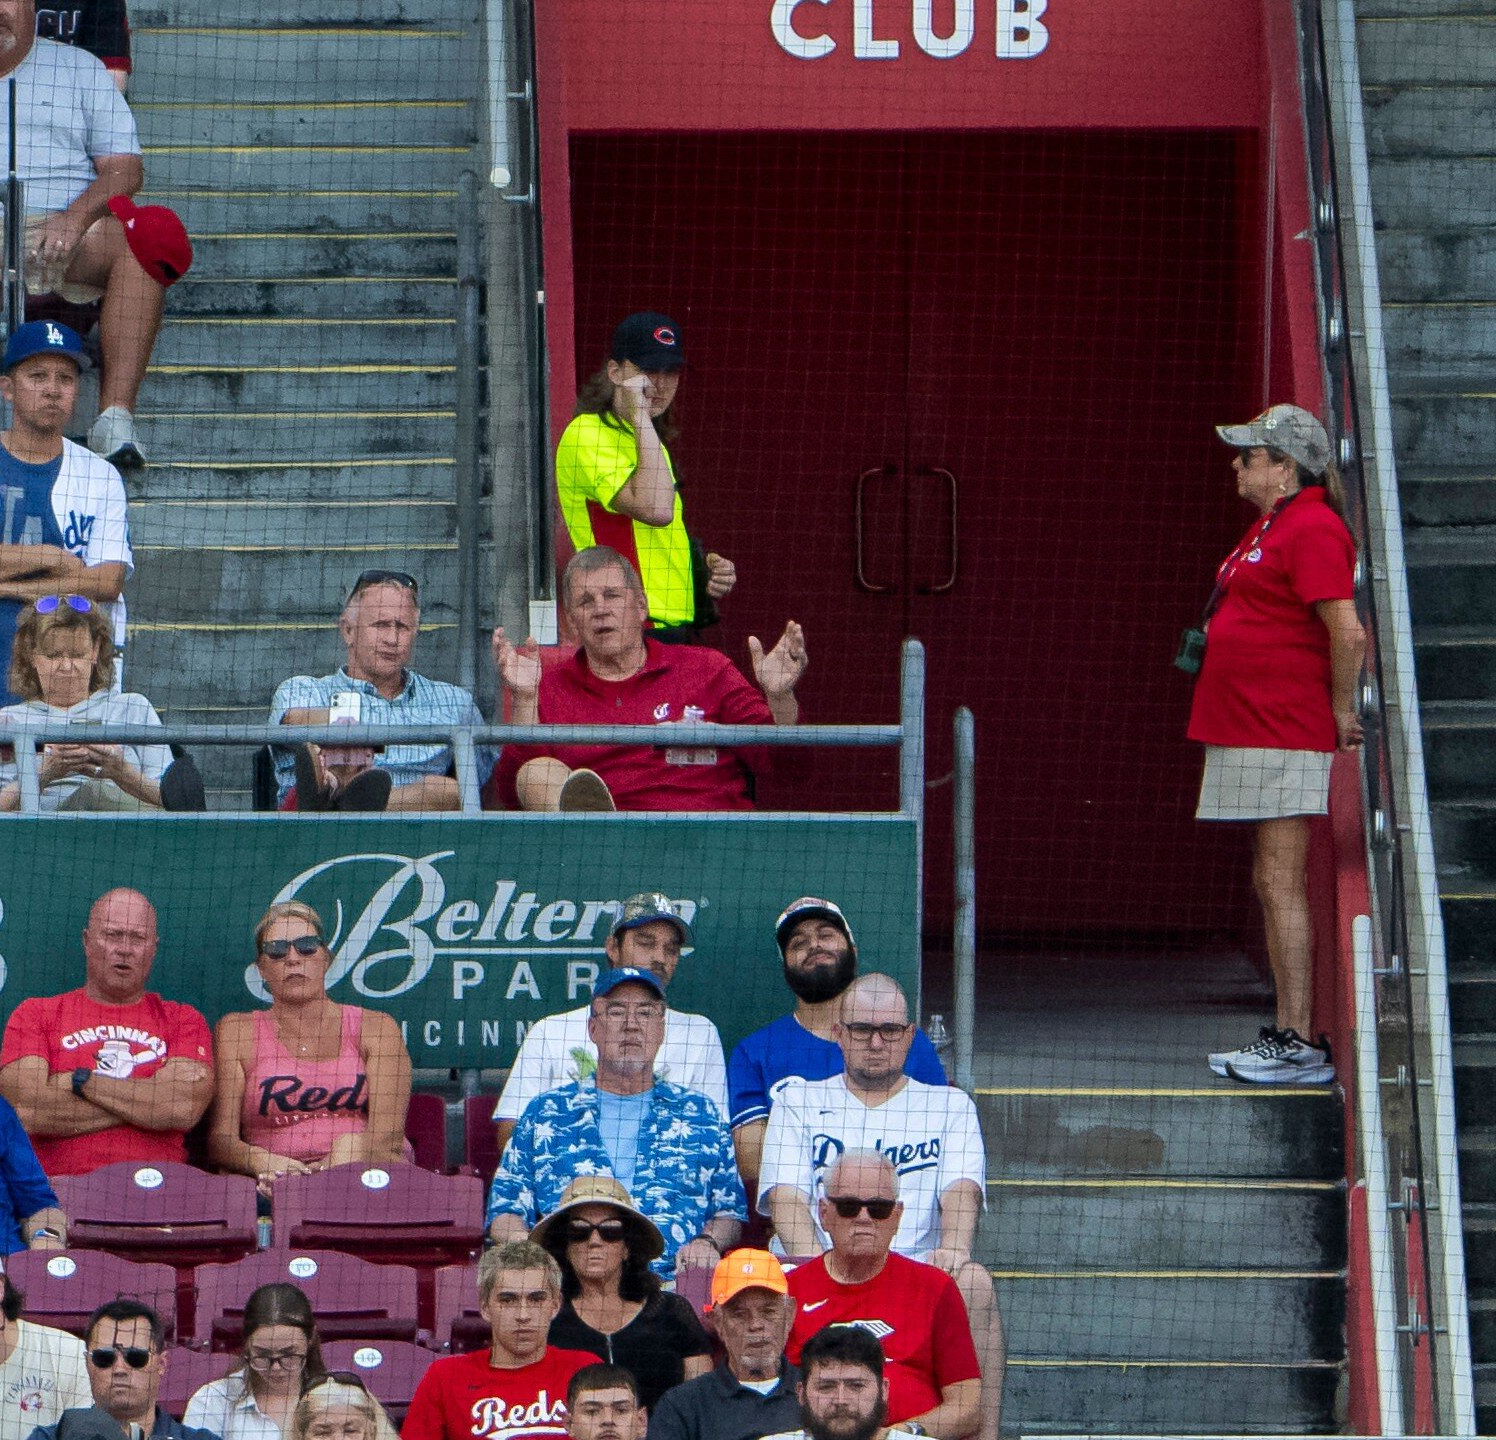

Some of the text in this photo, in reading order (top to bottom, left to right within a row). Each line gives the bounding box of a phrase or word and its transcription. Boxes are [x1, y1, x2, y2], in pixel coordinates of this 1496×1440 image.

[770, 0, 1051, 60] CLUB
[45, 322, 64, 346] LA
[653, 325, 675, 346] C
[244, 850, 695, 1000] Belter
[452, 960, 604, 1001] PAR
[258, 1074, 368, 1118] Red
[470, 1392, 570, 1440] Reds
